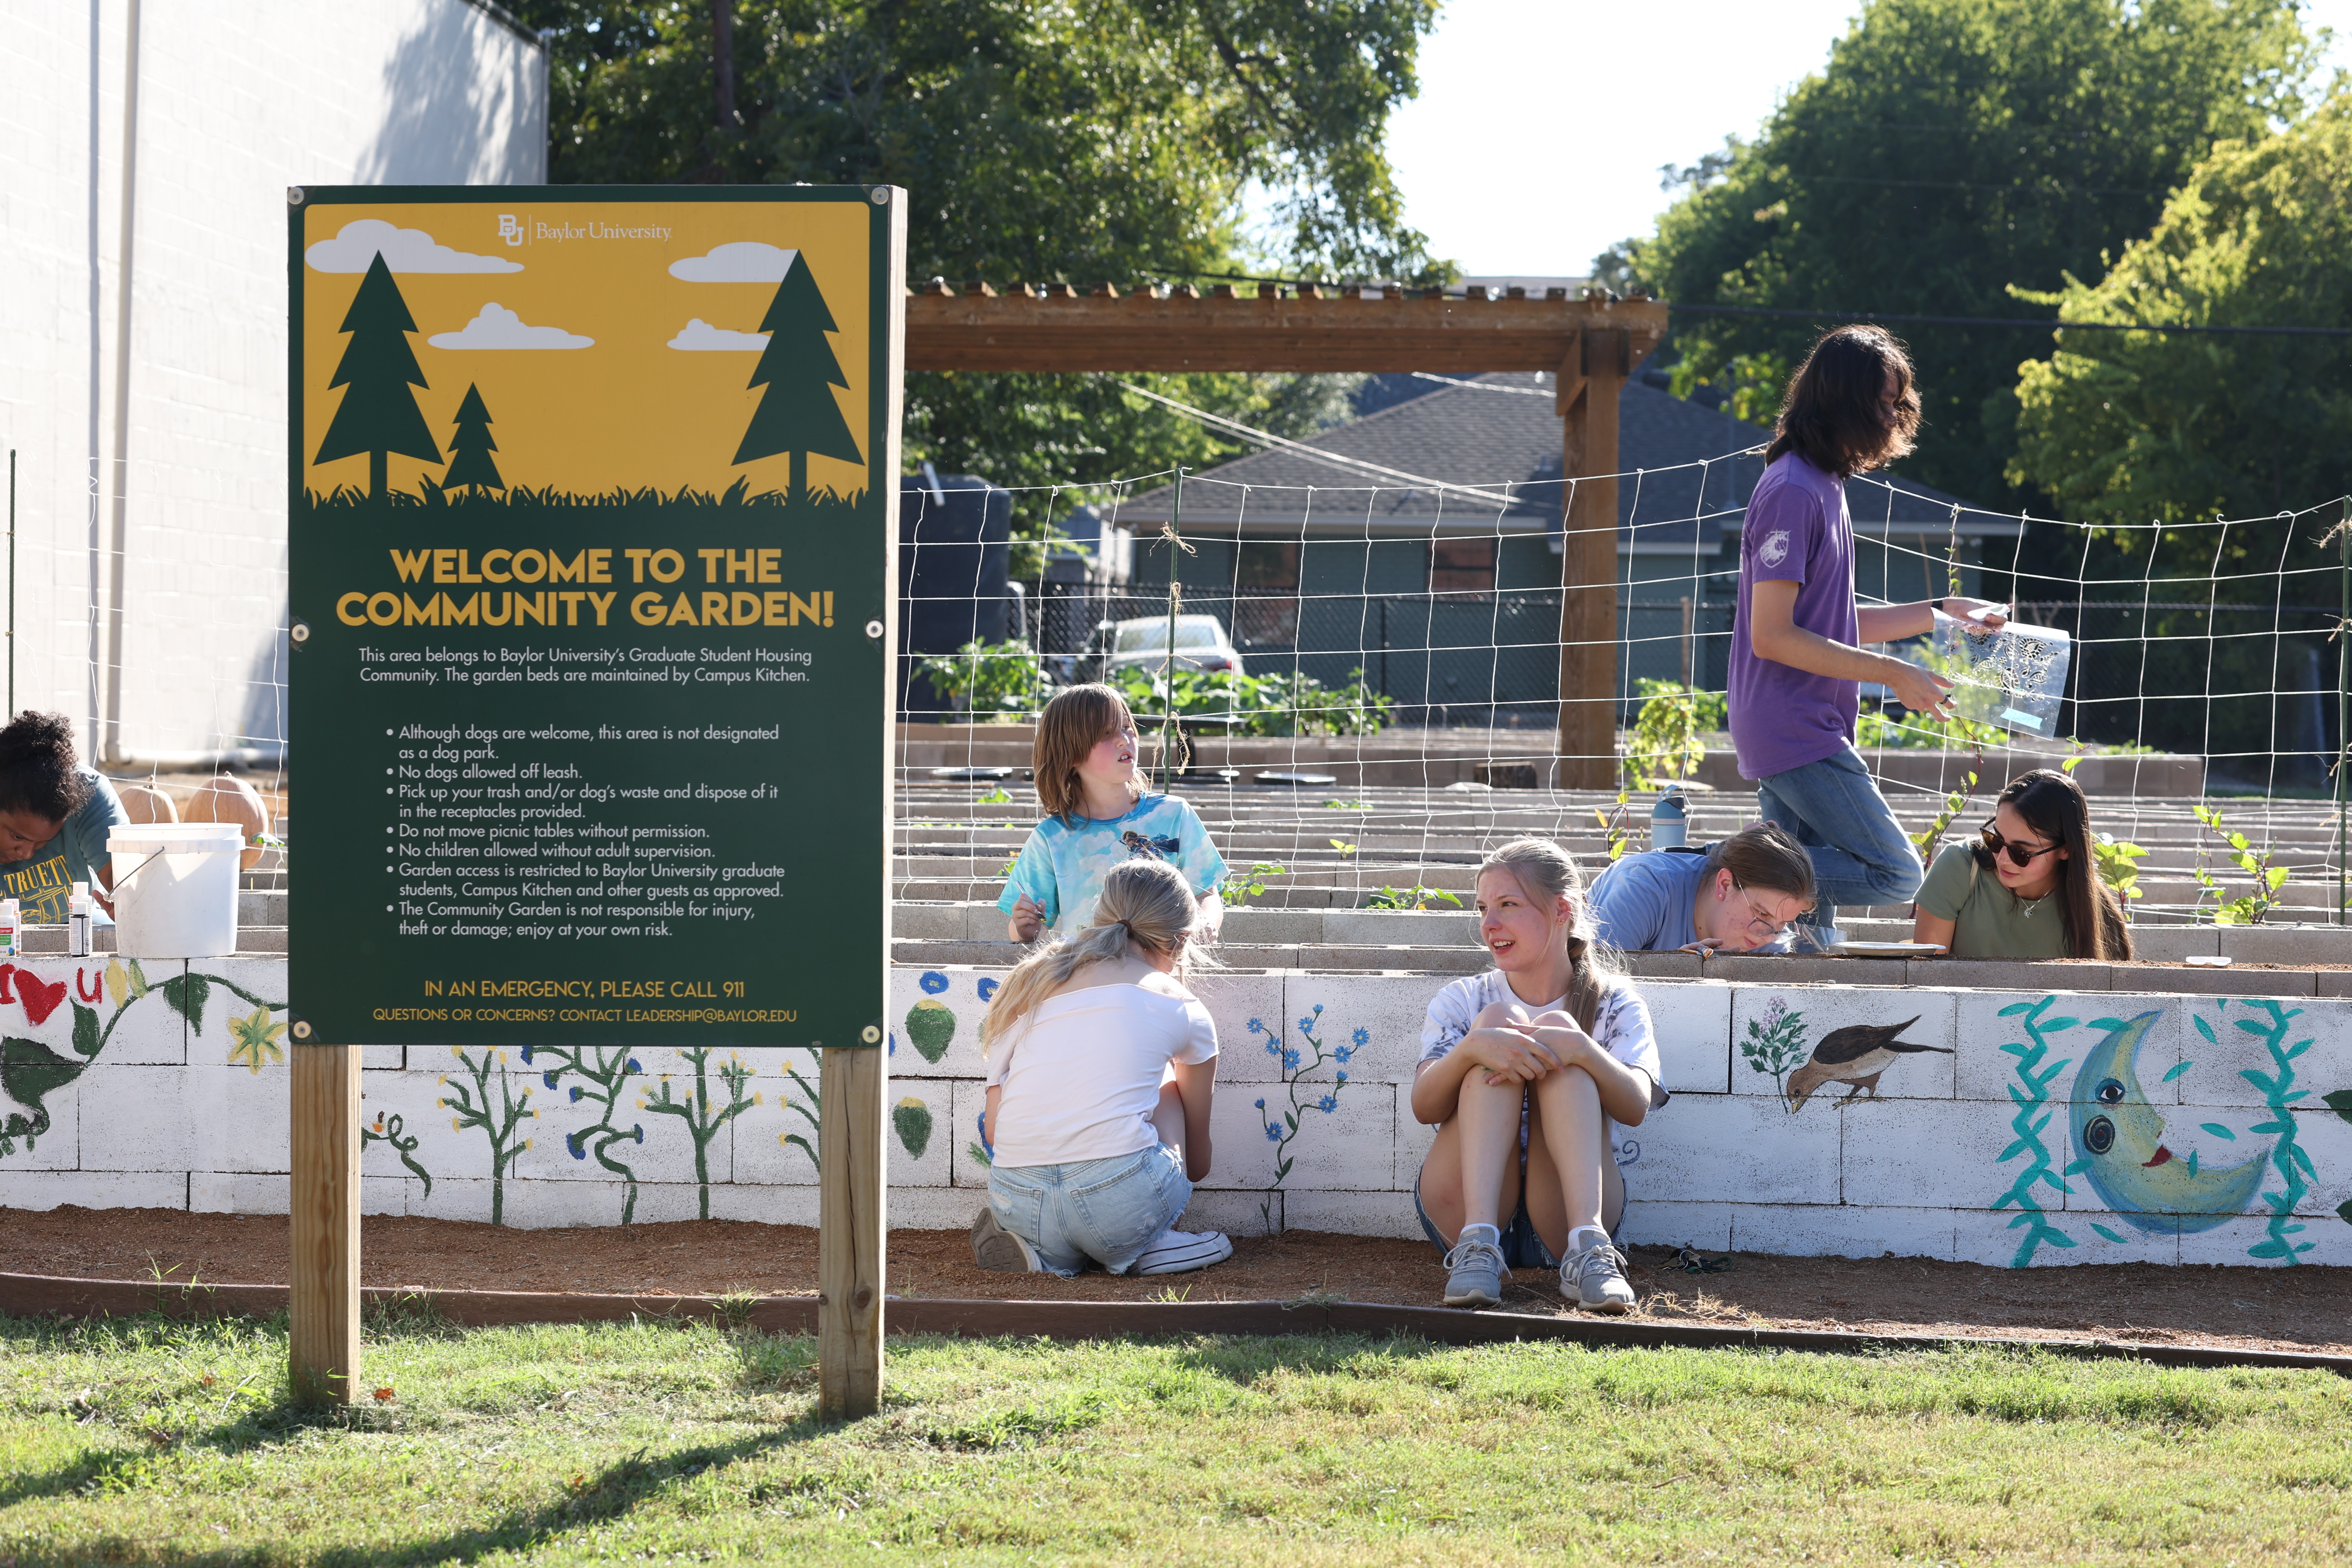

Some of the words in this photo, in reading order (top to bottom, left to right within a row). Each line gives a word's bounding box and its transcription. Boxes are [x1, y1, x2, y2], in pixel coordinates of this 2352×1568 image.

[536, 221, 586, 242] Baylor
[588, 221, 672, 242] University
[389, 548, 612, 583] WELCOME
[624, 548, 685, 583] TO
[697, 548, 782, 583] THE
[336, 591, 617, 626] COMMUNITY
[630, 591, 834, 628] GARDEN!
[358, 646, 385, 662] This
[389, 652, 421, 662] area
[426, 646, 479, 666] belongs
[483, 650, 496, 662] to
[501, 646, 545, 666] Baylor
[549, 648, 625, 666] University's
[629, 646, 696, 662] Graduate
[700, 646, 751, 662] Student
[755, 648, 812, 666] Housing
[360, 667, 439, 686] Community.
[444, 666, 469, 681] The
[473, 666, 522, 686] garden
[527, 666, 559, 681] beds
[563, 672, 587, 681] are
[592, 666, 668, 681] maintained
[673, 666, 690, 686] by
[694, 667, 751, 686] Campus
[756, 666, 809, 682] Kitchen.
[399, 724, 460, 743] Although
[465, 724, 498, 743] dogs
[502, 730, 526, 739] are
[530, 724, 594, 742] welcome,
[599, 724, 622, 739] this
[626, 730, 658, 739] area
[663, 726, 673, 739] is
[678, 727, 700, 739] not
[703, 724, 779, 744] designated
[399, 750, 414, 759] as
[419, 750, 428, 759] a
[432, 743, 459, 763] dog
[464, 743, 499, 763] park.
[399, 764, 421, 779] No
[425, 763, 458, 782] dogs
[462, 763, 516, 779] allowed
[520, 763, 539, 779] off
[543, 763, 582, 779] leash.
[399, 782, 426, 798] Pick
[430, 789, 448, 802] up
[452, 789, 483, 802] your
[487, 782, 520, 798] trash
[525, 782, 576, 800] and/or
[579, 782, 616, 802] dog's
[620, 786, 660, 799] waste
[663, 783, 690, 799] and
[695, 782, 747, 802] dispose
[751, 782, 766, 799] of
[769, 785, 779, 799] it
[399, 804, 412, 817] in
[416, 802, 437, 818] the
[441, 802, 516, 822] receptacles
[521, 802, 585, 822] provided.
[399, 823, 419, 837] Do
[423, 825, 445, 837] not
[449, 828, 485, 837] move
[490, 824, 530, 841] picnic
[534, 822, 574, 837] tables
[578, 822, 628, 838] without
[632, 824, 710, 842] permission.
[399, 843, 421, 857] No
[425, 841, 479, 857] children
[484, 841, 537, 857] allowed
[541, 841, 592, 857] without
[595, 842, 630, 857] adult
[634, 844, 715, 861] supervision.
[4, 855, 73, 894] TRUETT
[399, 861, 451, 876] Garden
[456, 867, 500, 877] access
[505, 863, 515, 877] is
[519, 861, 581, 877] restricted
[585, 865, 599, 877] to
[603, 861, 647, 881] Baylor
[651, 863, 718, 881] University
[722, 862, 785, 881] graduate
[399, 880, 457, 898] students,
[462, 882, 518, 900] Campus
[523, 881, 572, 896] Kitchen
[576, 881, 603, 897] and
[607, 881, 643, 897] other
[647, 884, 689, 901] guests
[693, 887, 709, 897] as
[713, 881, 784, 901] approved.
[398, 900, 423, 915] The
[427, 902, 505, 920] Community
[508, 900, 561, 916] Garden
[566, 902, 577, 916] is
[581, 904, 603, 916] not
[607, 900, 684, 920] responsible
[688, 900, 708, 916] for
[713, 903, 755, 921] injury,
[399, 919, 428, 935] theft
[432, 926, 447, 935] or
[451, 920, 512, 939] damage;
[516, 922, 554, 940] enjoy
[558, 924, 572, 936] at
[575, 926, 607, 940] your
[611, 926, 640, 936] own
[645, 920, 672, 936] risk.
[425, 980, 442, 996] IN
[448, 980, 475, 996] AN
[481, 980, 595, 999] EMERGENCY,
[601, 981, 665, 998] PLEASE
[670, 981, 717, 998] CALL
[723, 981, 744, 998] 911
[373, 1008, 448, 1020] QUESTIONS
[452, 1009, 472, 1021] OR
[476, 1009, 555, 1021] CONCERNS?
[559, 1009, 622, 1022] CONTACT
[626, 1008, 797, 1024] LEADERSHIP@BAYLOR.EDU
